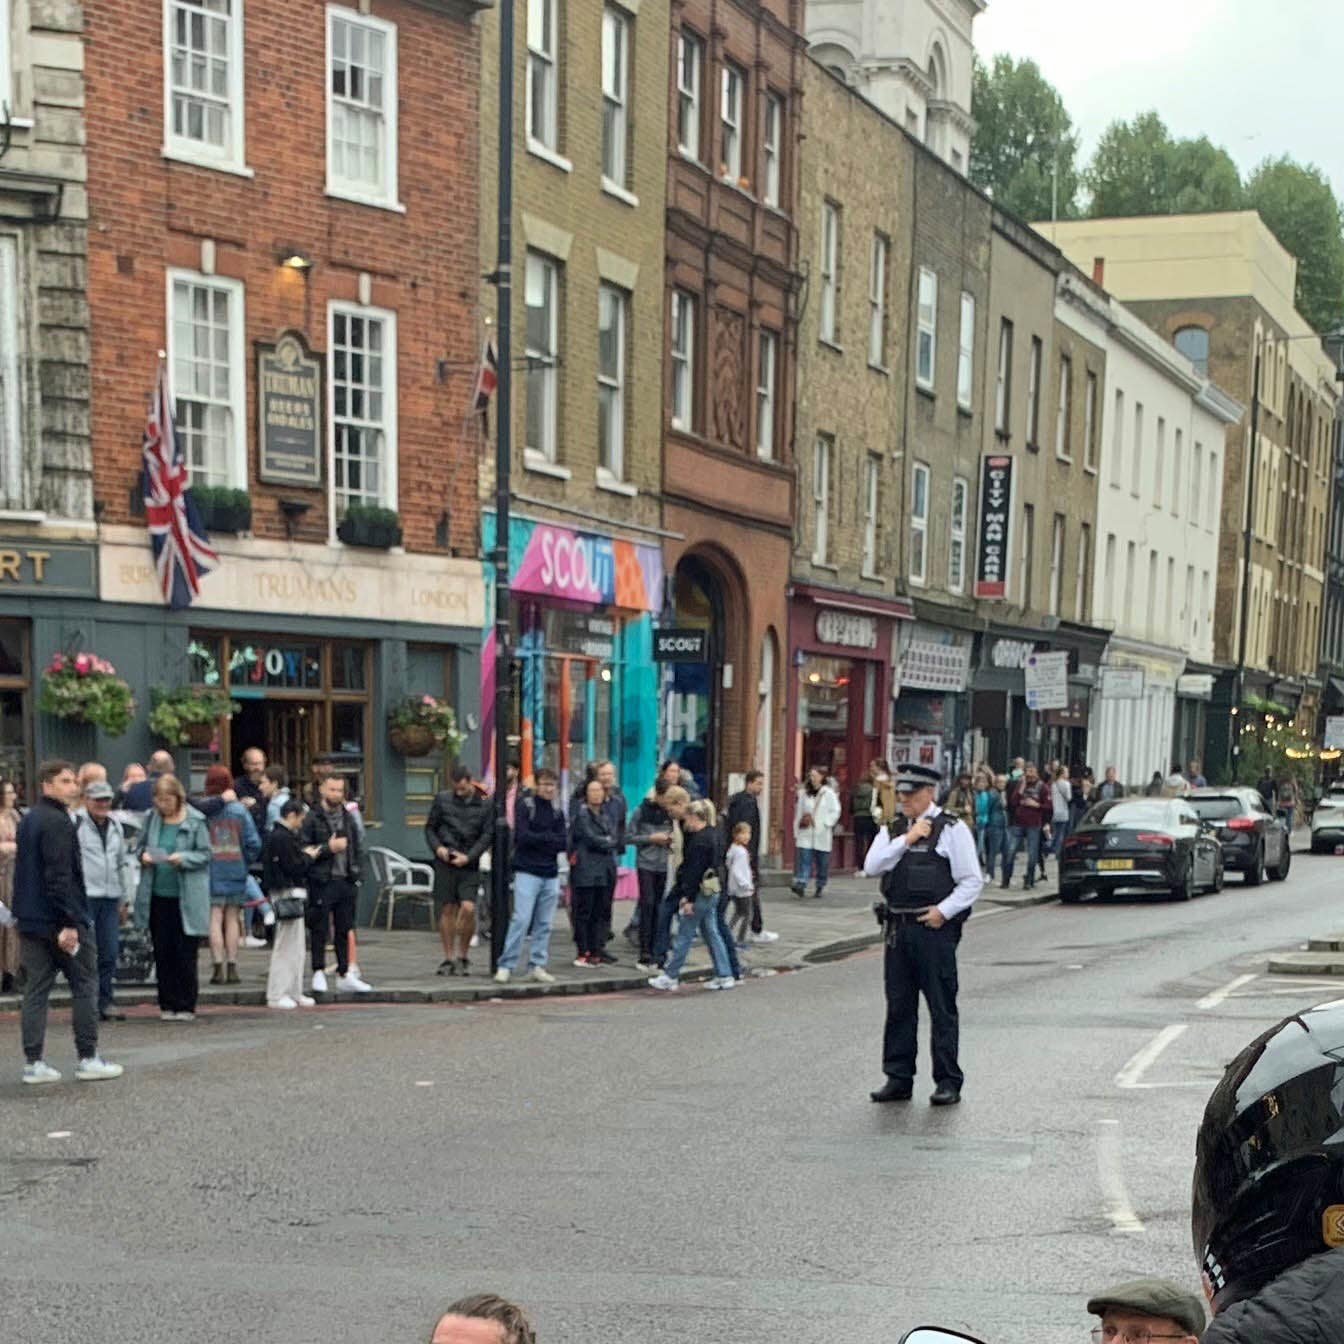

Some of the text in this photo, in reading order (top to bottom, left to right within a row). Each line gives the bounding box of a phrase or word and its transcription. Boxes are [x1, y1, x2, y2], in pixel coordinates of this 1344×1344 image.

[541, 530, 611, 594] SCOUT
[411, 587, 470, 609] LONDON
[658, 637, 702, 651] SCOUT
